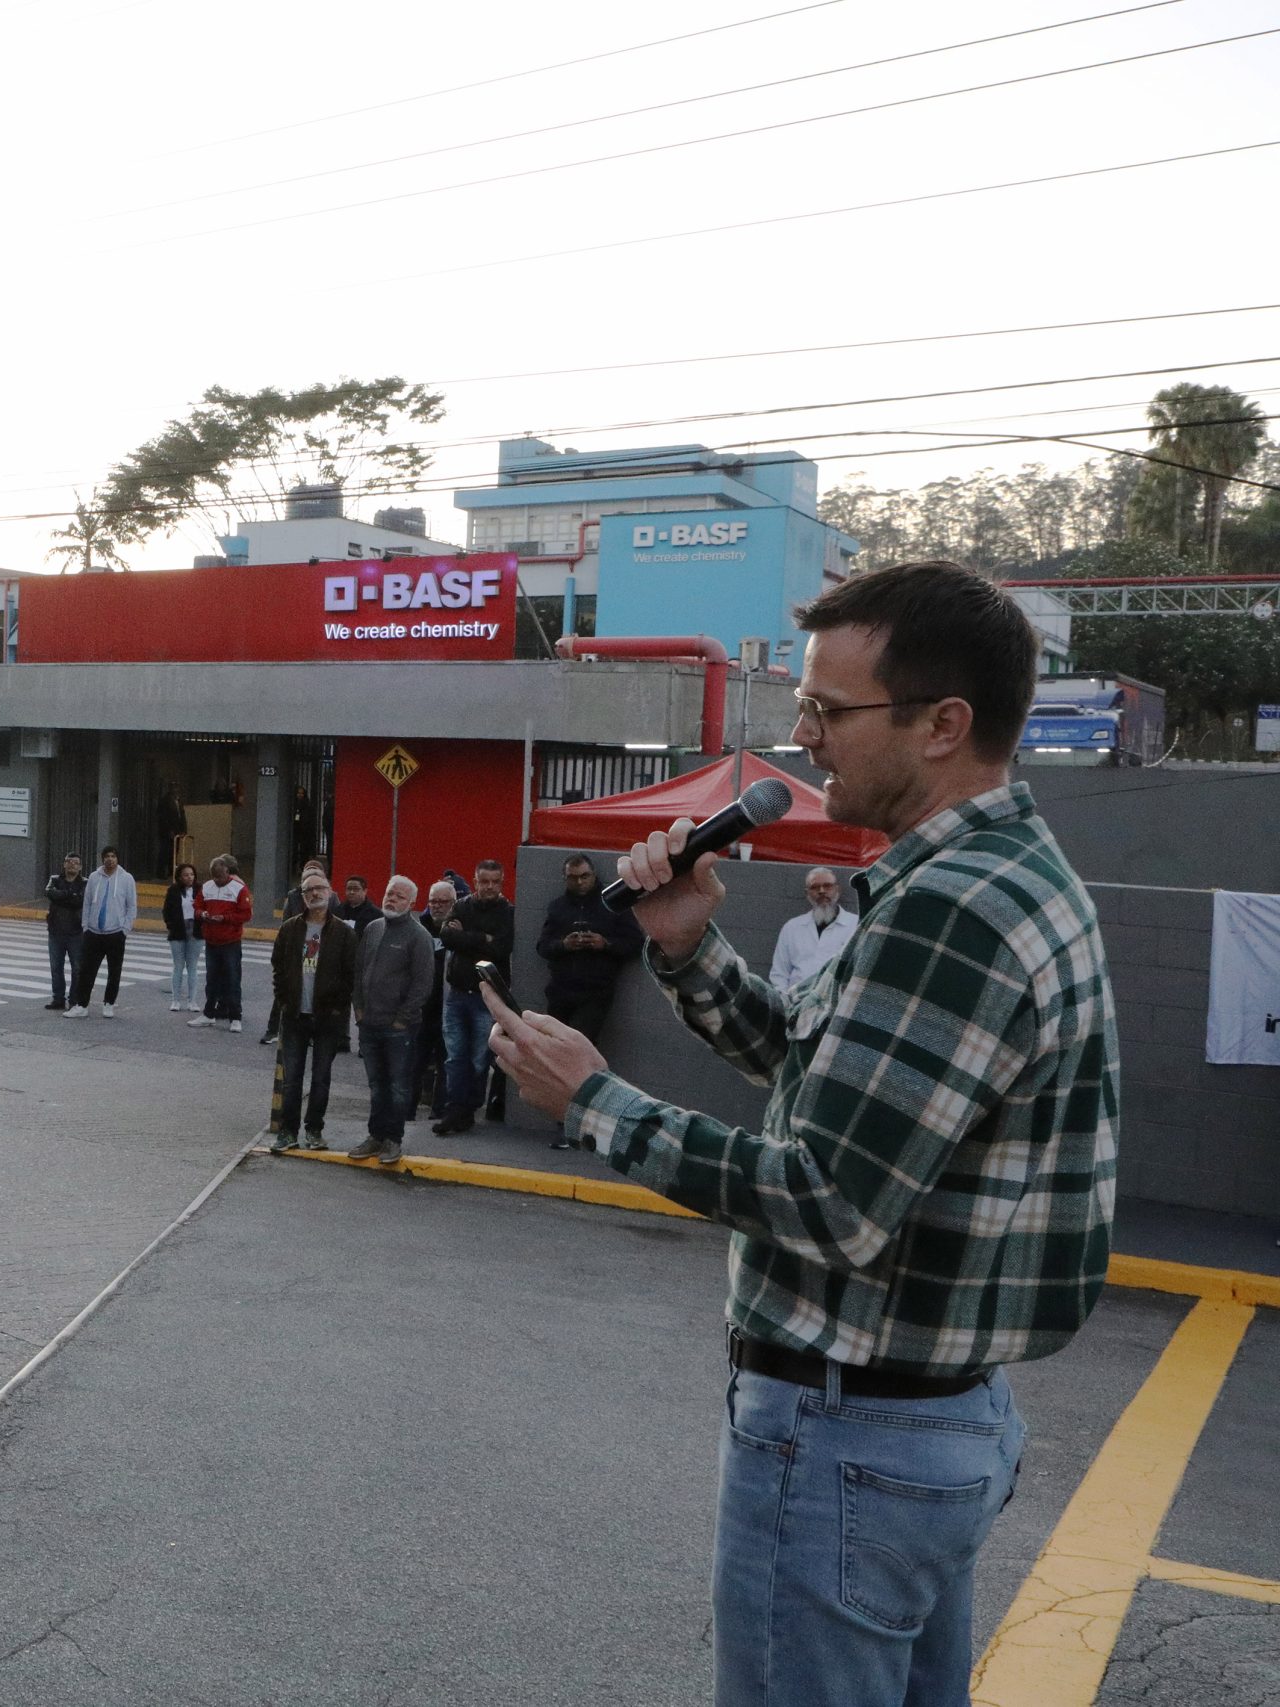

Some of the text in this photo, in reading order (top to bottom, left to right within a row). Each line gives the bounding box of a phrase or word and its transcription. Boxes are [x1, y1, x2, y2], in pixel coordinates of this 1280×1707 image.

[671, 522, 748, 546] BASF
[634, 550, 746, 562] We create chemistry
[383, 570, 501, 609] BASF
[325, 620, 500, 641] We create chemistry
[261, 766, 275, 775] 123
